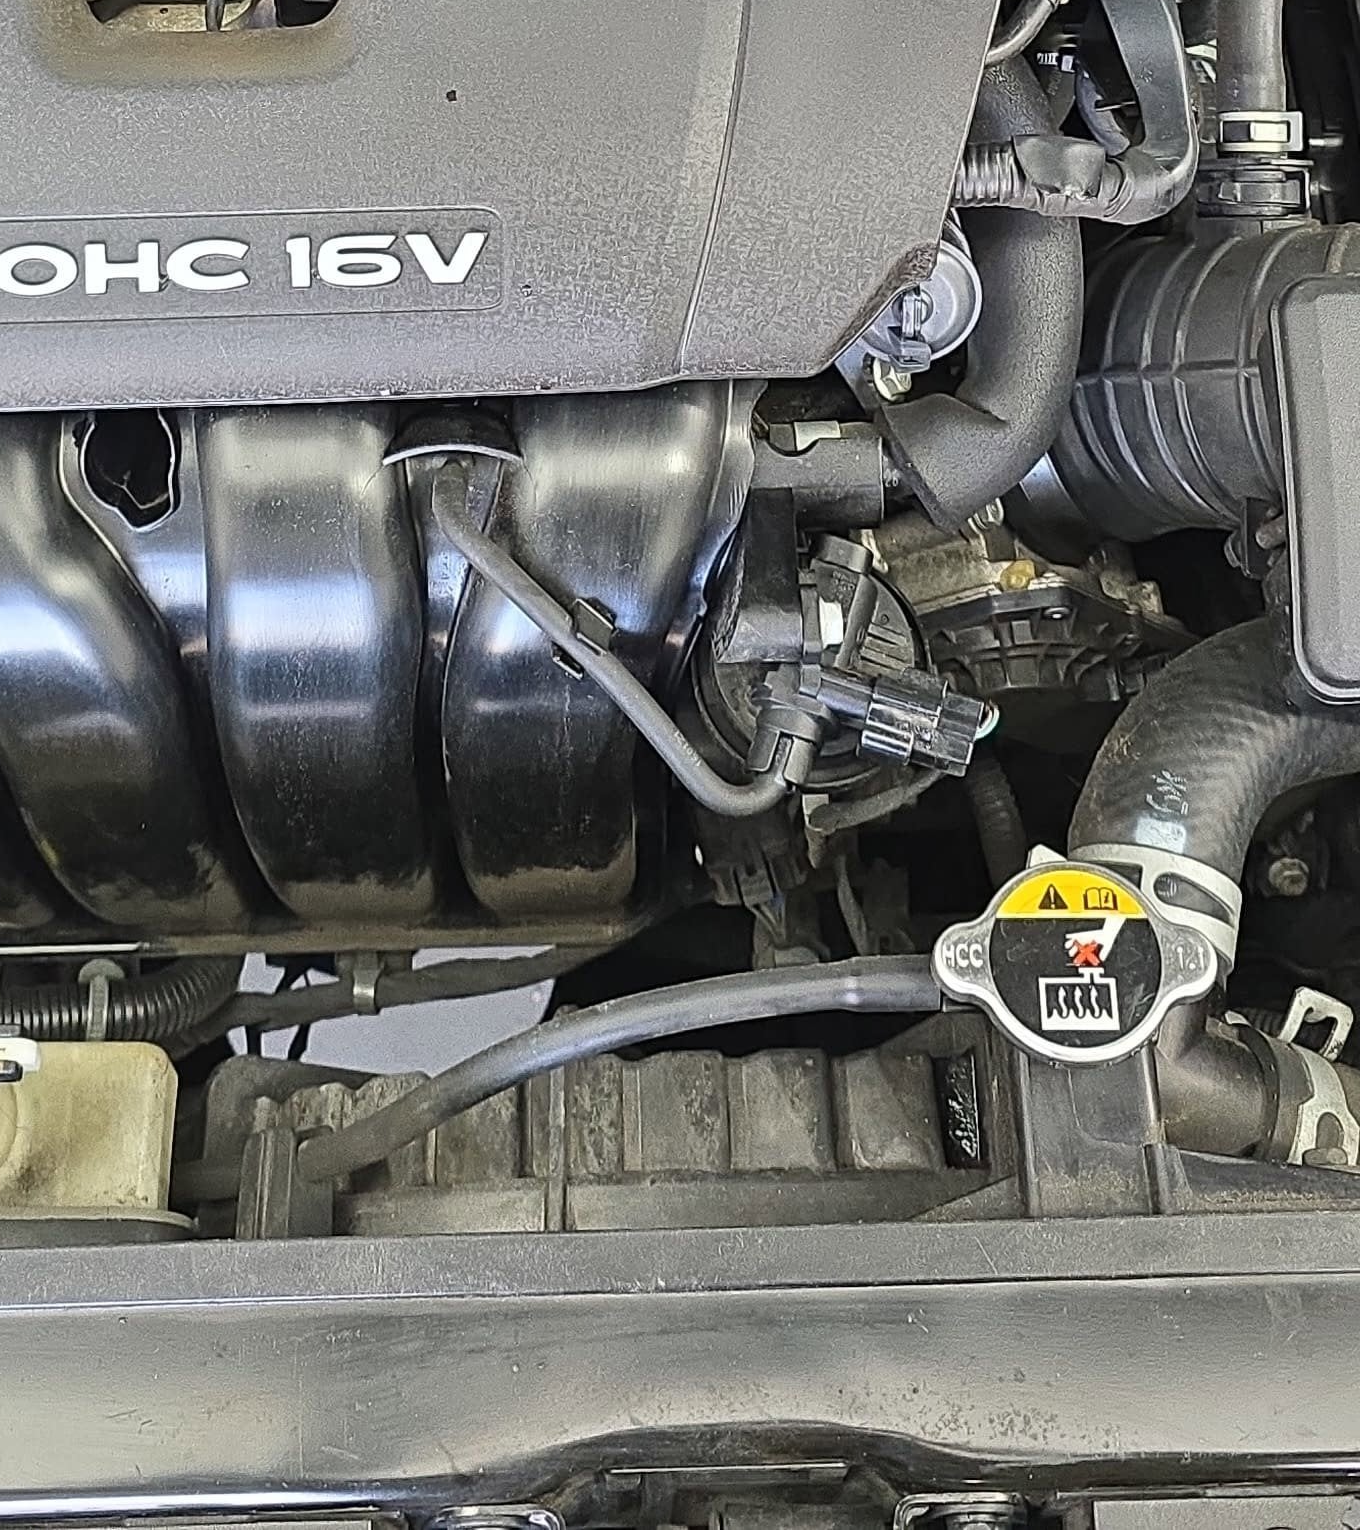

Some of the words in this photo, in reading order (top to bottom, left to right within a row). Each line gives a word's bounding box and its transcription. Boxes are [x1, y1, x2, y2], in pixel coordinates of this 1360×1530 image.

[284, 230, 490, 290] 16V
[941, 943, 984, 969] HCC
[1175, 945, 1205, 971] 1.1
